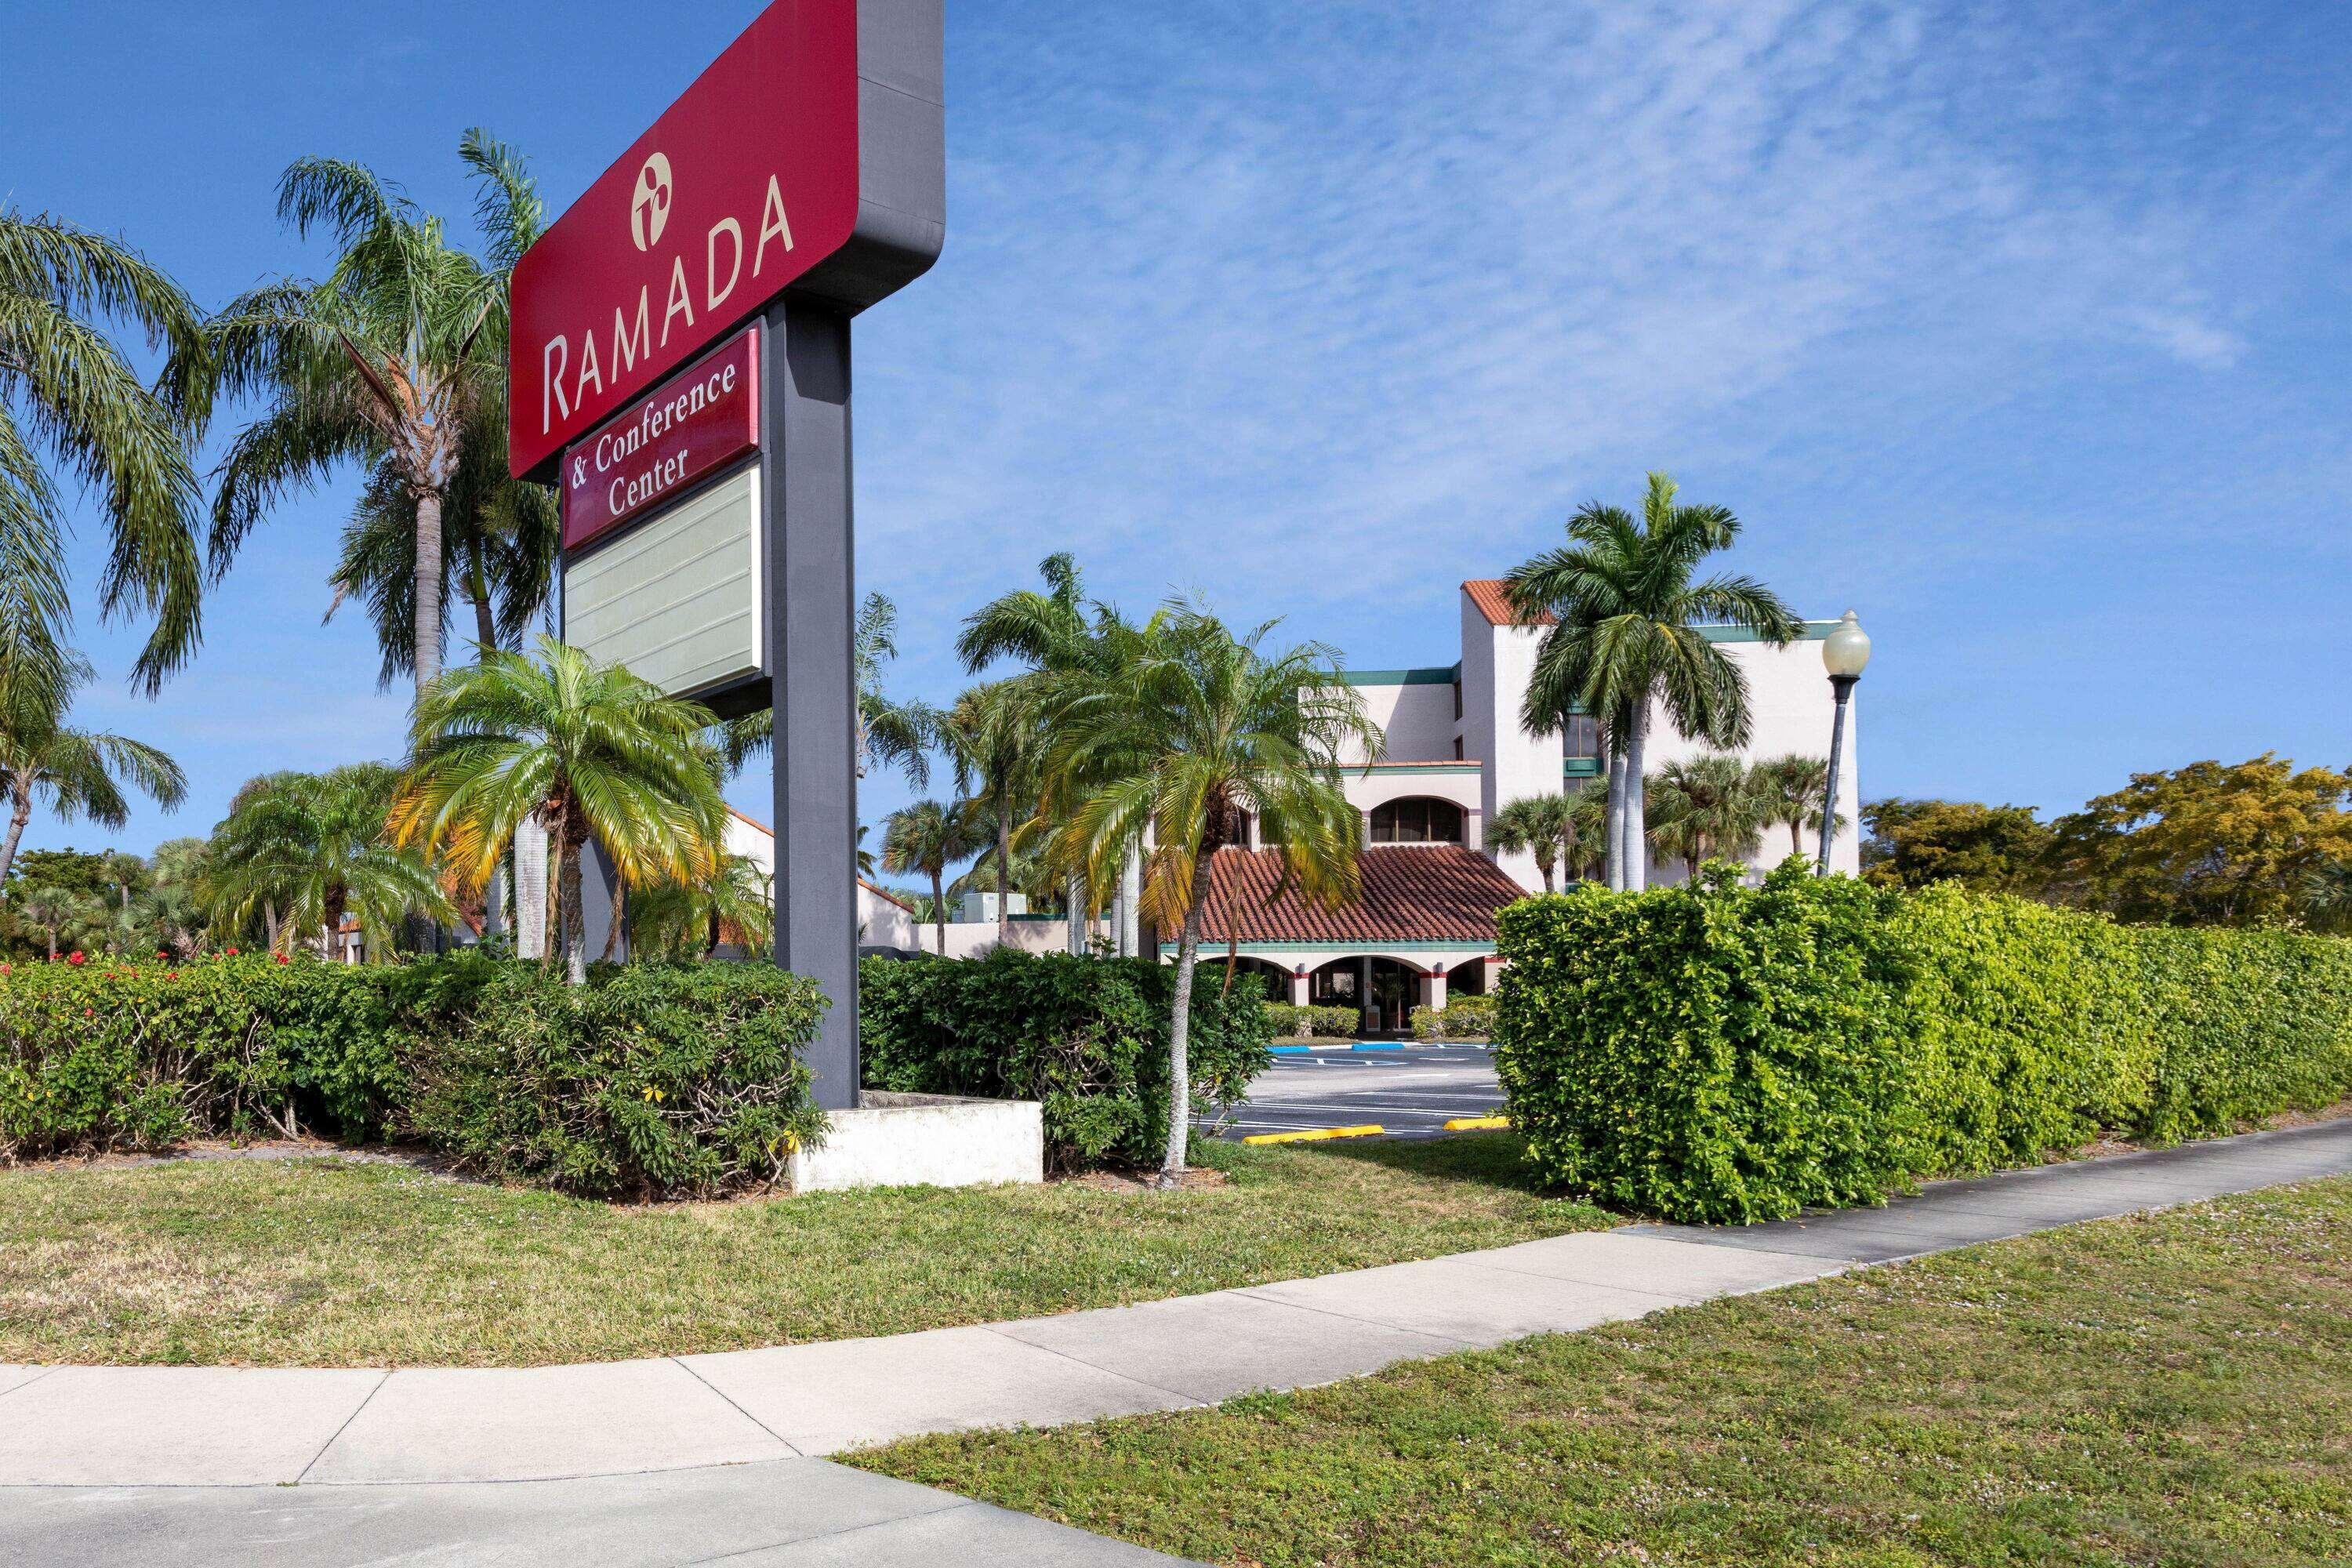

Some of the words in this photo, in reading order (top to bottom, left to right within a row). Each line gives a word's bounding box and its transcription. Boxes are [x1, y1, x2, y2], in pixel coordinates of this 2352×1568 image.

[543, 173, 793, 436] RAMADA
[572, 456, 587, 490] &
[596, 363, 736, 473] Conference
[609, 447, 689, 516] Center
